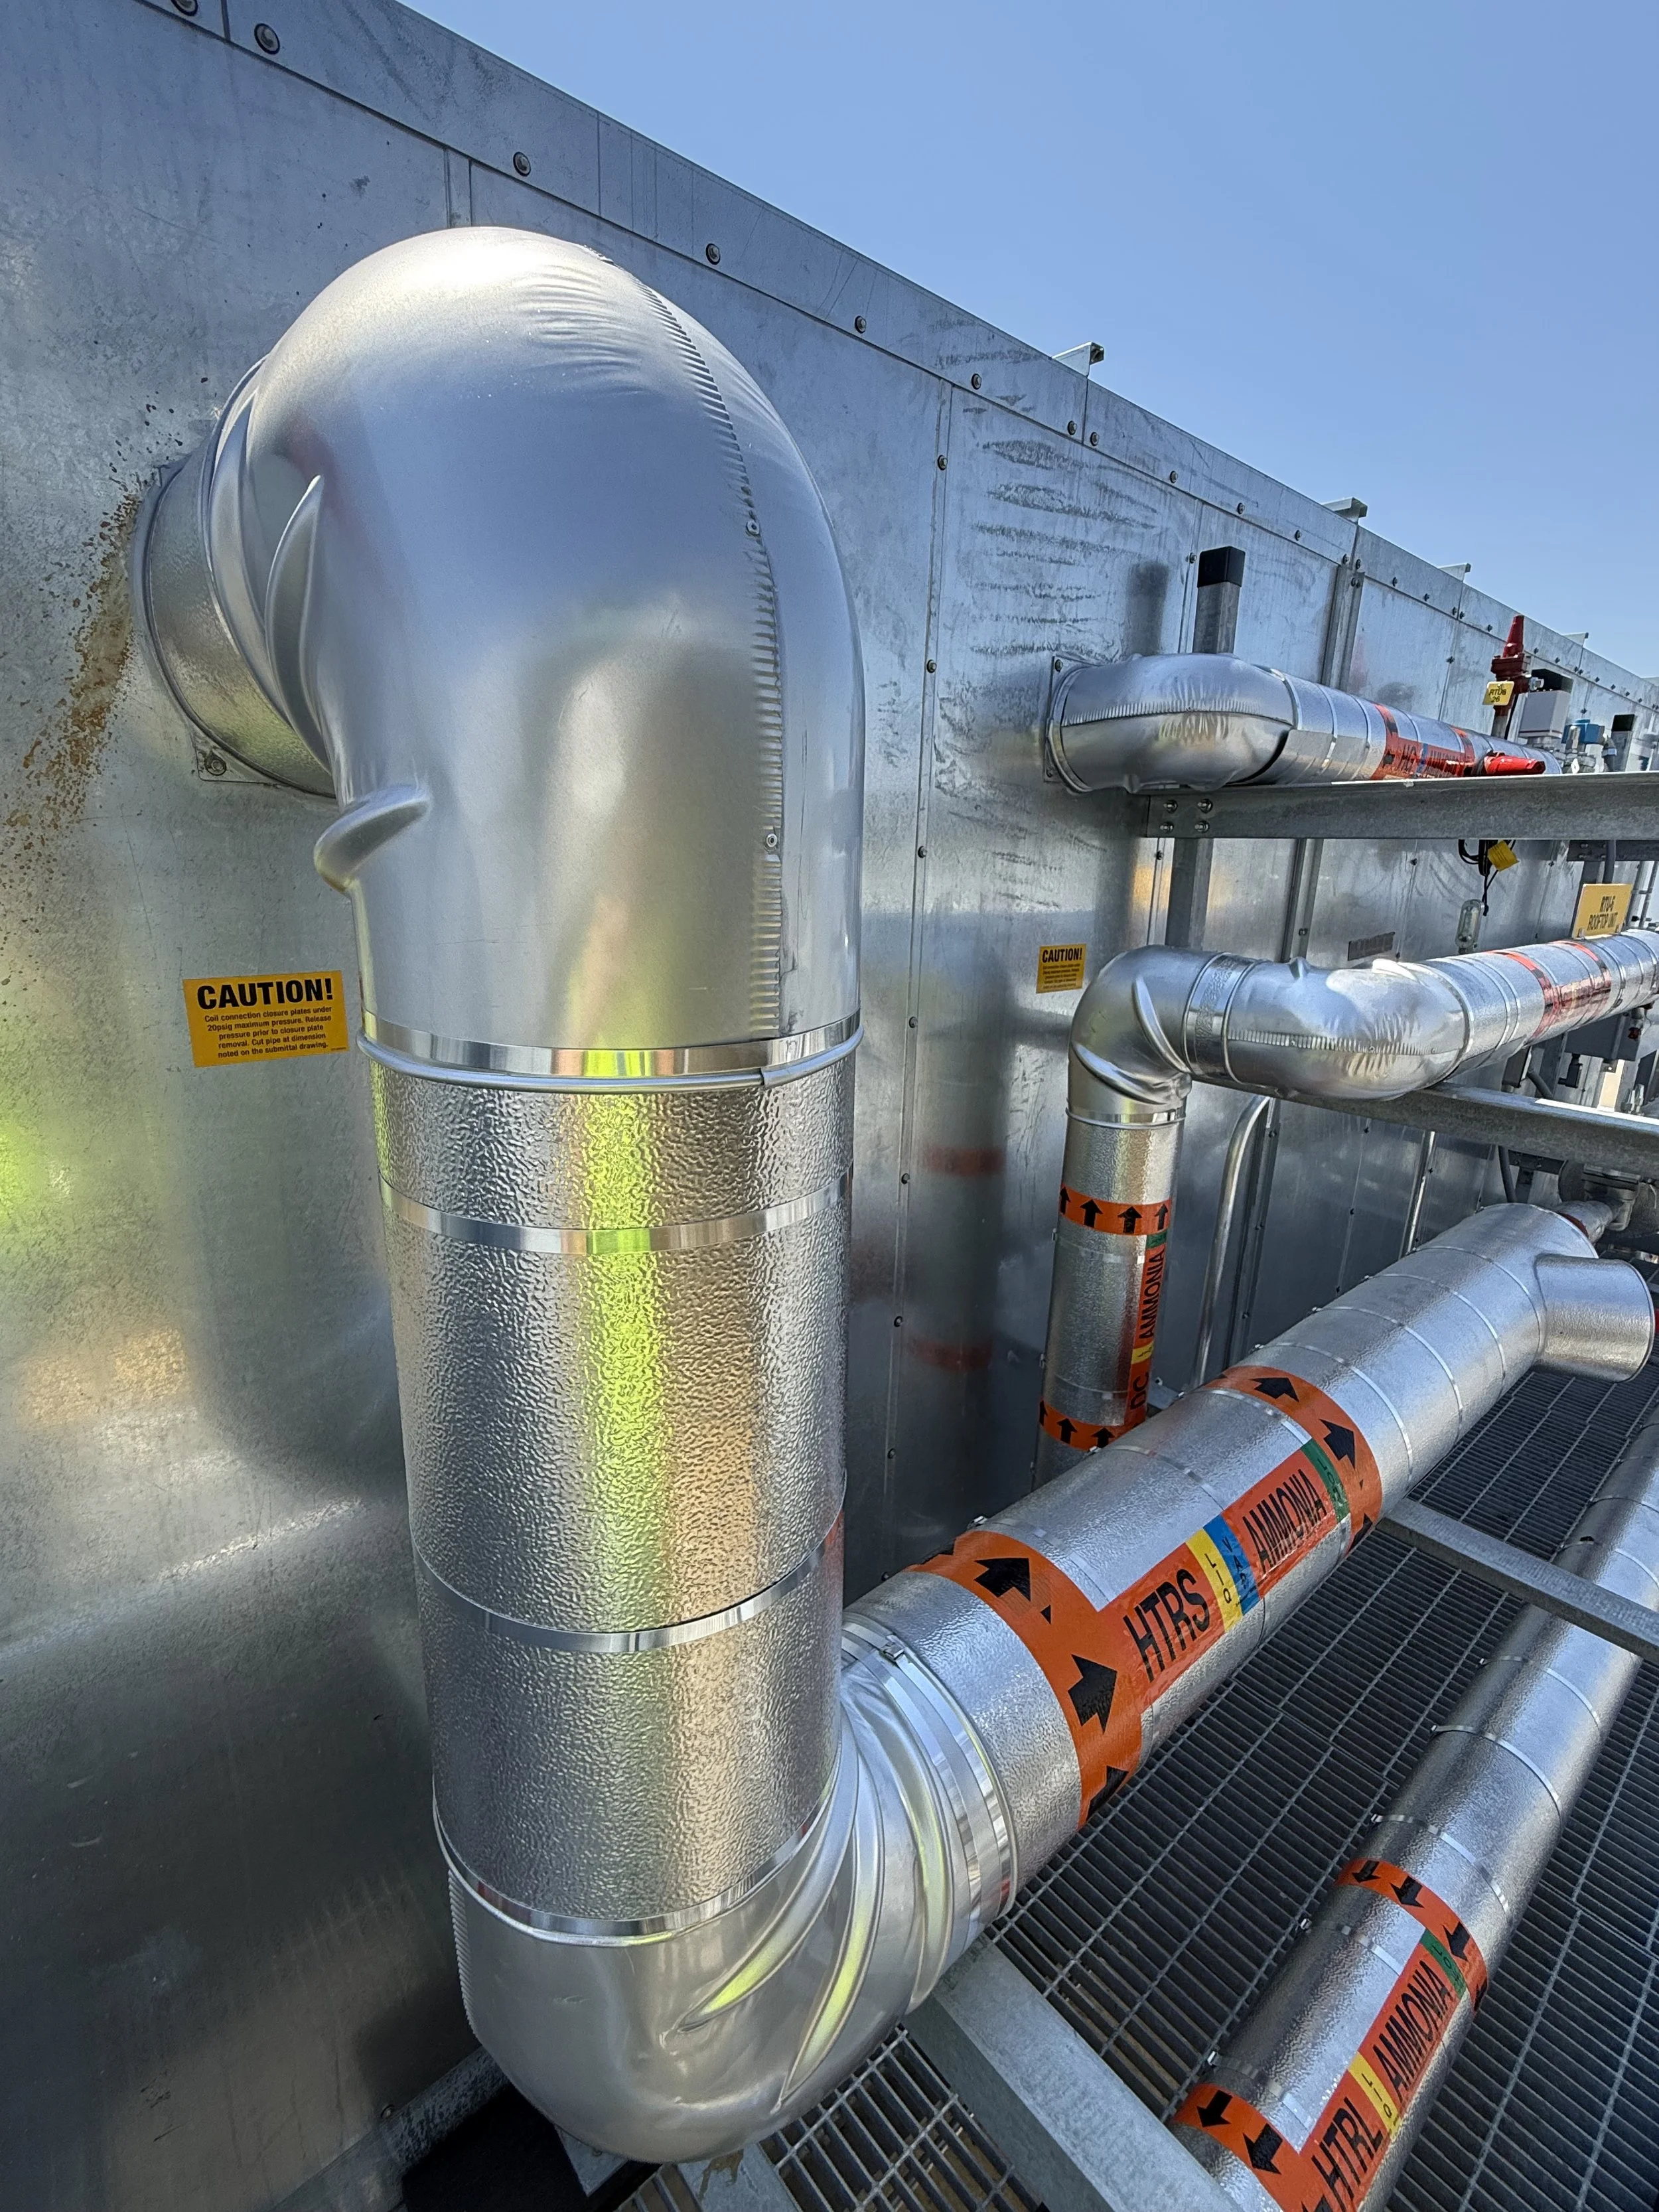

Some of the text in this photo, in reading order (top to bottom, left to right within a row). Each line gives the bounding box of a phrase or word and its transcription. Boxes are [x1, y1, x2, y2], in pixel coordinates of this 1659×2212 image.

[1043, 947, 1082, 963] CAUTION!
[197, 978, 333, 1009] CAUTION!
[221, 1011, 261, 1021] connection
[234, 1021, 270, 1029] maximum
[218, 1031, 251, 1041] pressure
[252, 1029, 269, 1037] prior
[307, 1024, 324, 1033] plate
[265, 1043, 297, 1053] submittal
[299, 1041, 328, 1050] drawing.
[291, 1033, 326, 1042] dimension
[1139, 1249, 1165, 1339] AMMONIA
[1131, 1371, 1149, 1410] DC
[1123, 1469, 1327, 1683] HTRS AMMONIA
[1204, 1553, 1233, 1604] LIQ
[1311, 1960, 1453, 2212] HTRL AMMONIA
[1361, 2073, 1392, 2118] LIQ
